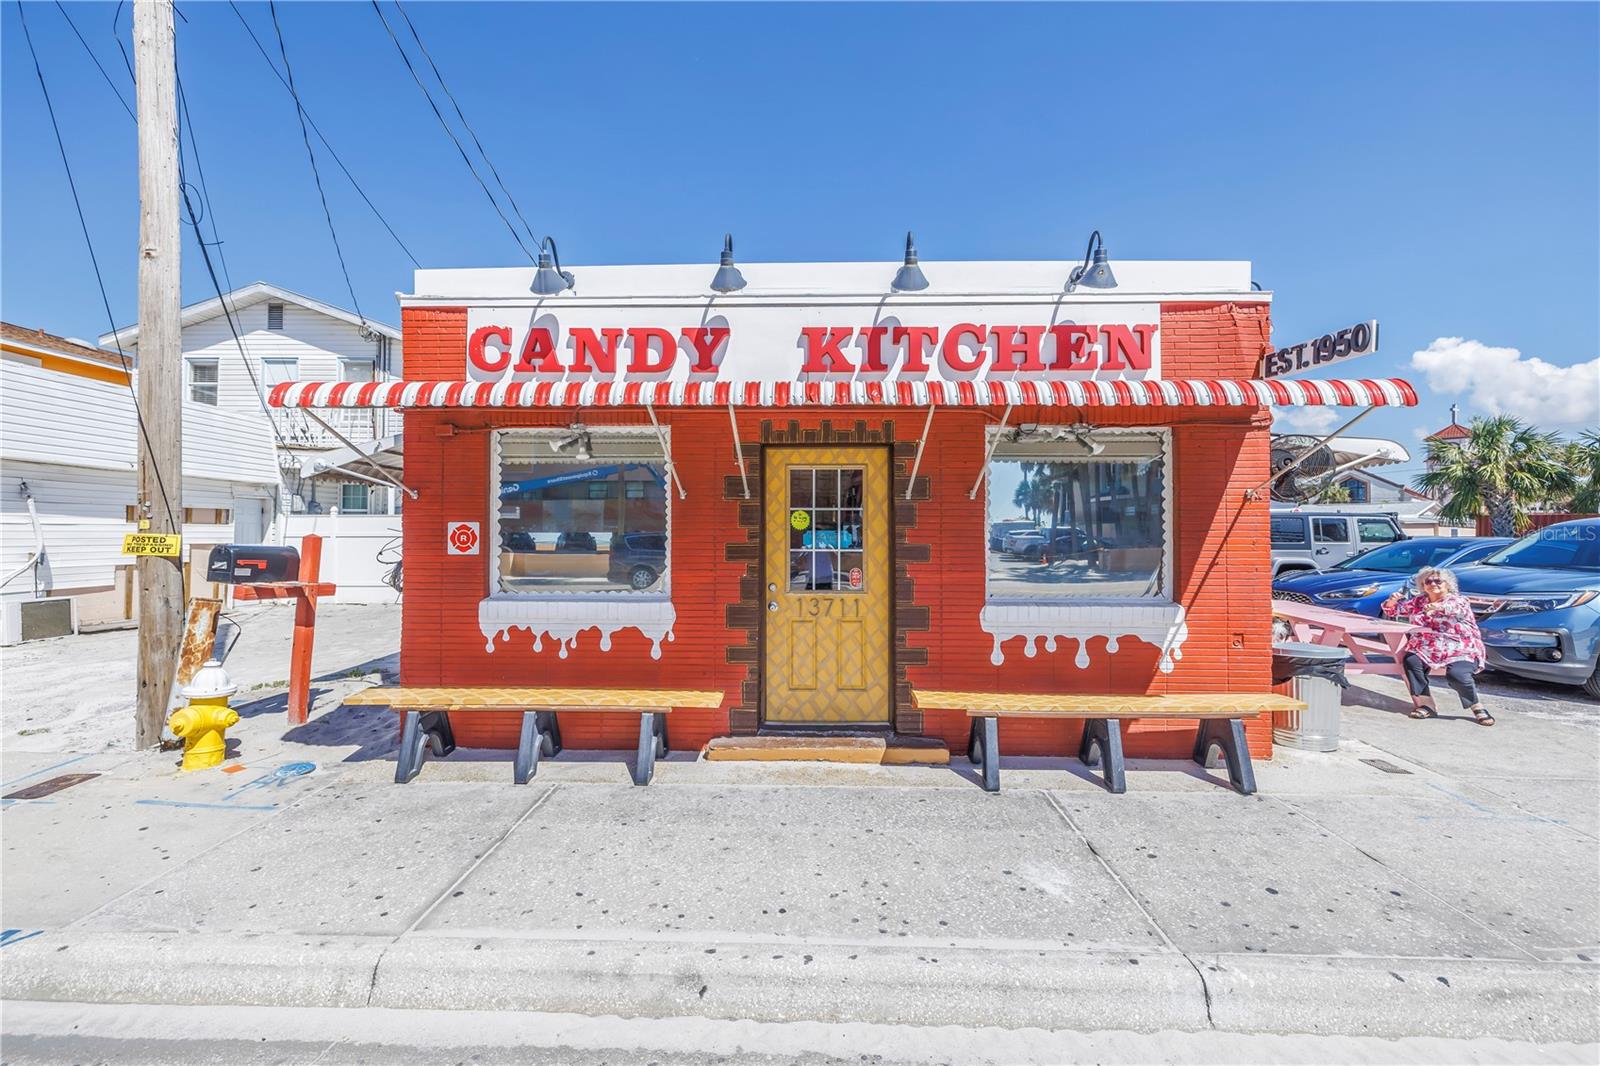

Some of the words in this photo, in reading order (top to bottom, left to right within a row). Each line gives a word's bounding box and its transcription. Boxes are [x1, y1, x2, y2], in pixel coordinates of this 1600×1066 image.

[468, 325, 731, 374] CANDY
[801, 322, 1159, 373] KITCHEN
[798, 597, 859, 618] 13711
